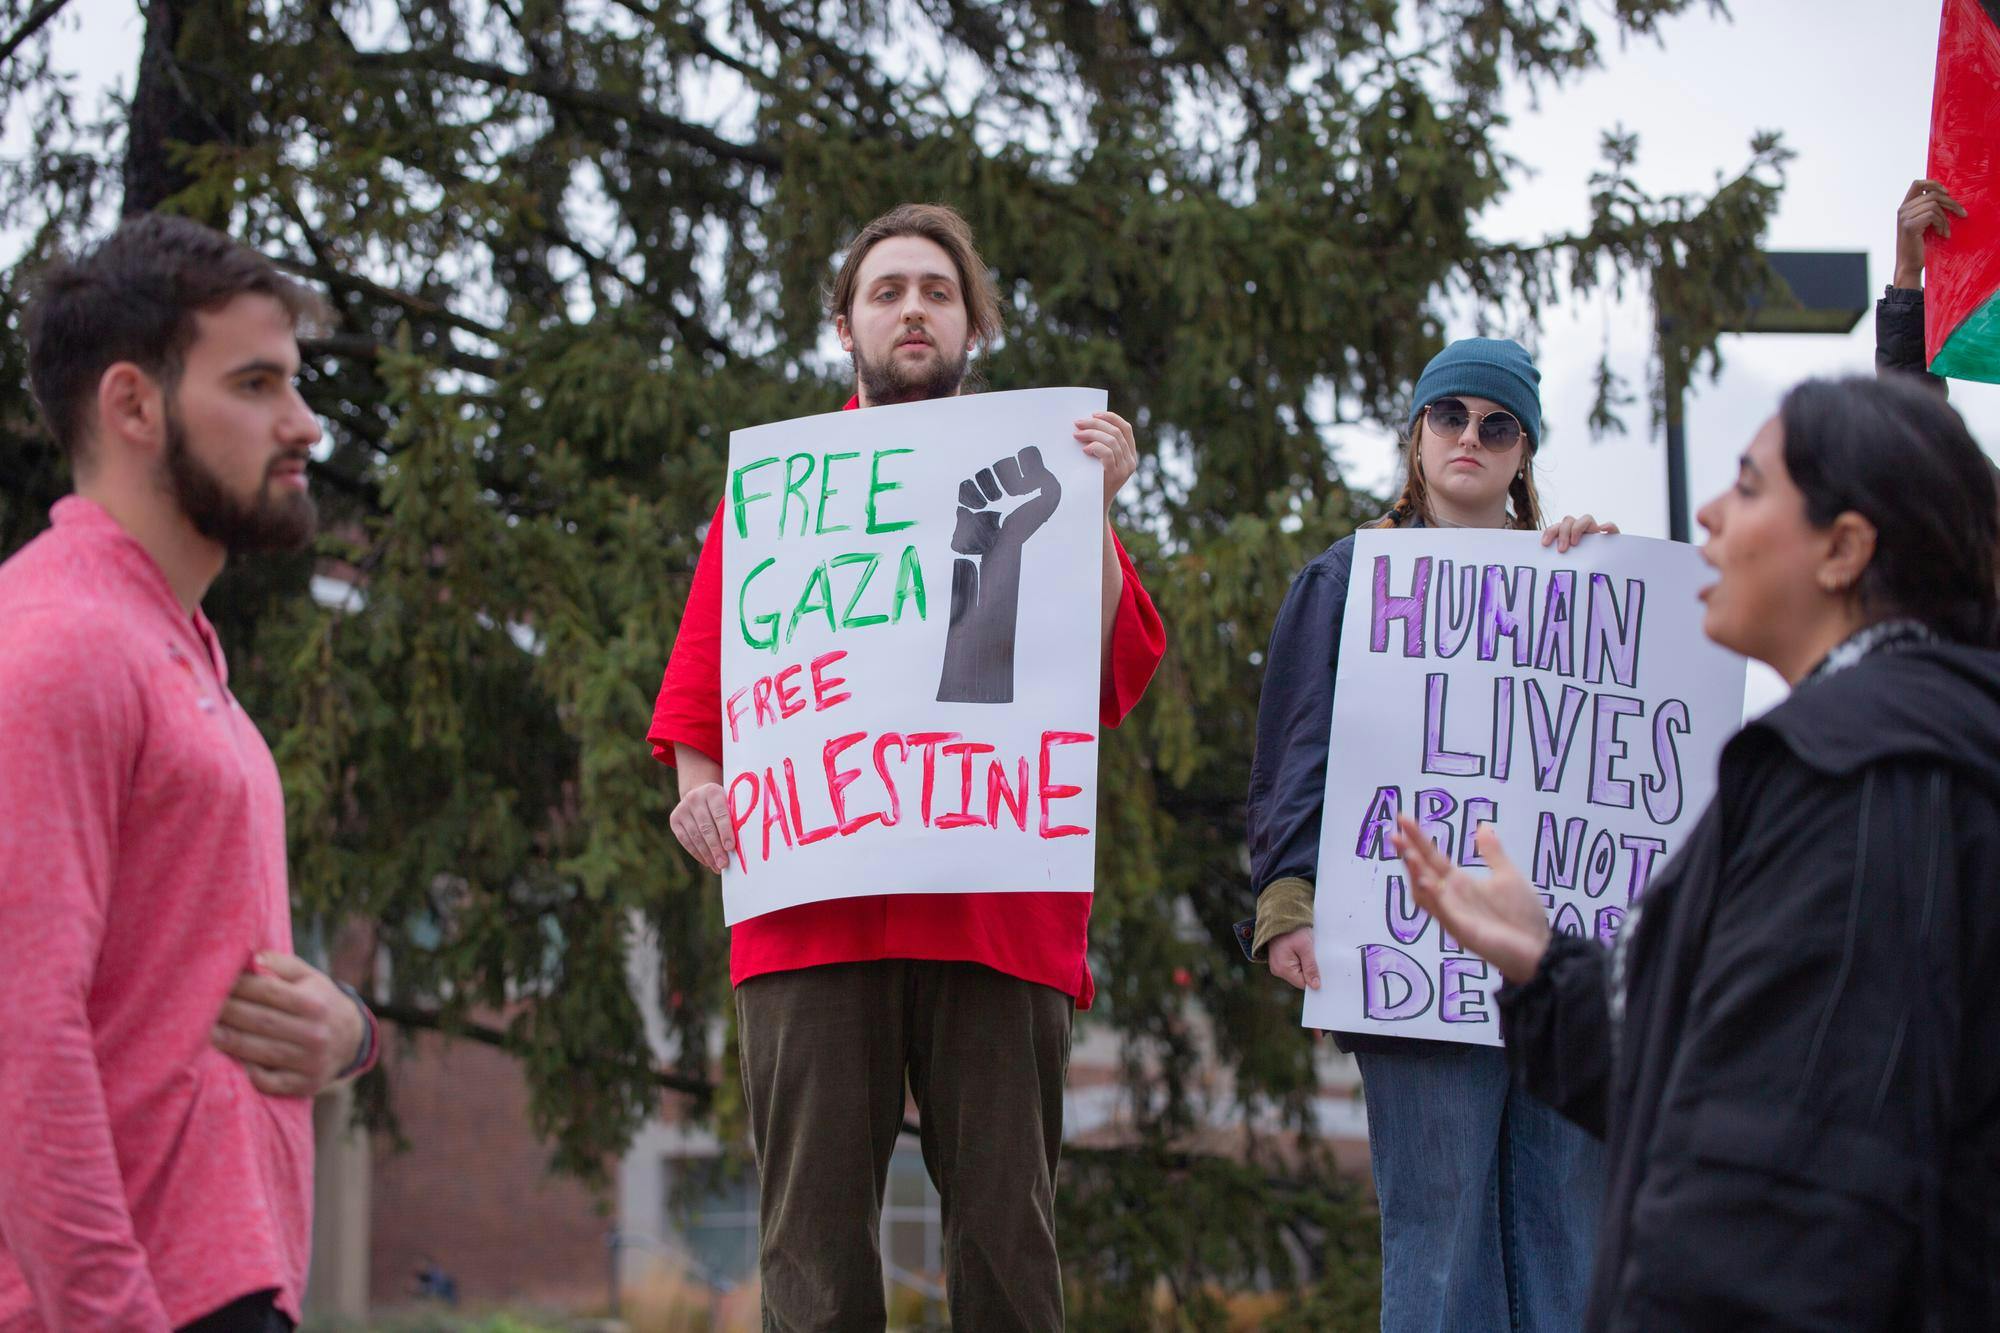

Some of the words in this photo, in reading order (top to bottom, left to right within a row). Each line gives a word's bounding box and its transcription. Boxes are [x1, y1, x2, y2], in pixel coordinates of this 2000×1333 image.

[732, 447, 919, 540] FREE
[739, 545, 927, 654] GAZA
[1369, 555, 1645, 688] HUMAN
[726, 650, 852, 742] FREE
[1421, 673, 1691, 825] LIVES
[728, 731, 1095, 875] PALESTINE
[1355, 785, 1498, 867] ARE
[1532, 811, 1667, 905] NOT
[1385, 875, 1464, 954] U
[1356, 944, 1503, 1040] DE
